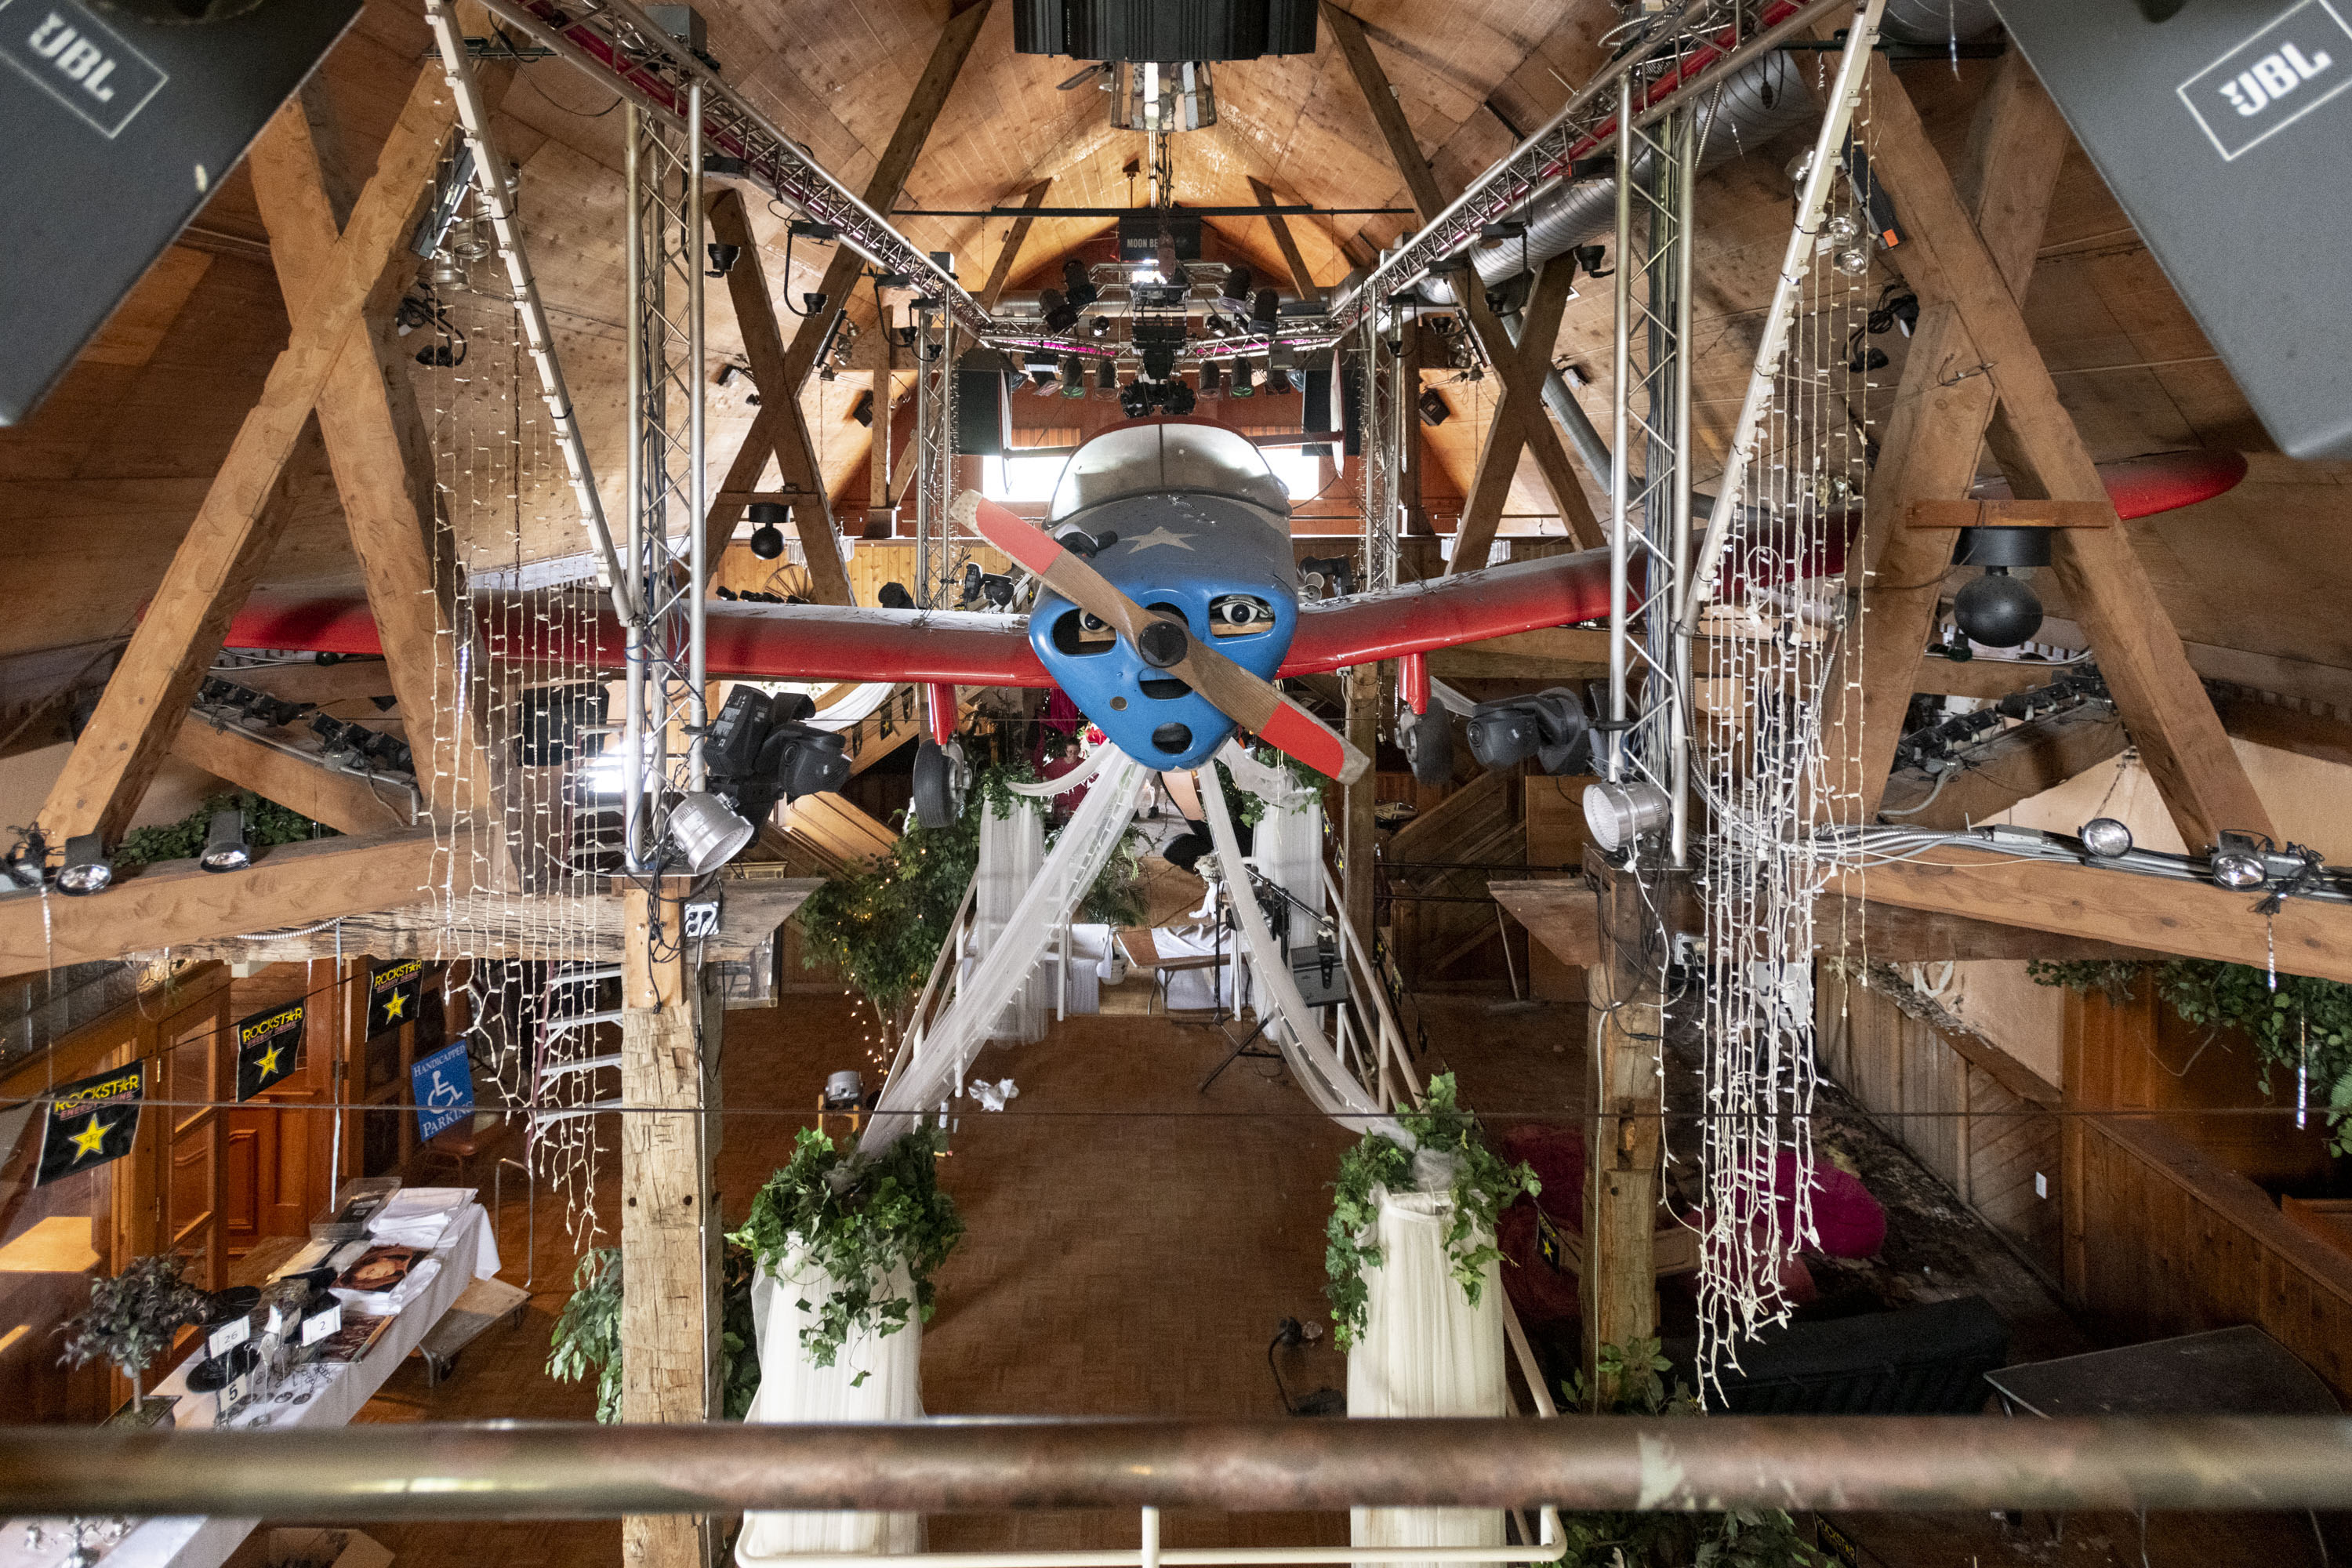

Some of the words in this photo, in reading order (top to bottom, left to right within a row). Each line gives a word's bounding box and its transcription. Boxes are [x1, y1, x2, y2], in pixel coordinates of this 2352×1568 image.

[29, 12, 117, 103] JBL
[2218, 42, 2333, 117] JBL
[1127, 238, 1148, 249] MOON
[413, 1045, 466, 1078] HANDICAPPED
[319, 1321, 326, 1331] 2
[224, 1332, 238, 1344] 26
[229, 1384, 238, 1401] 5
